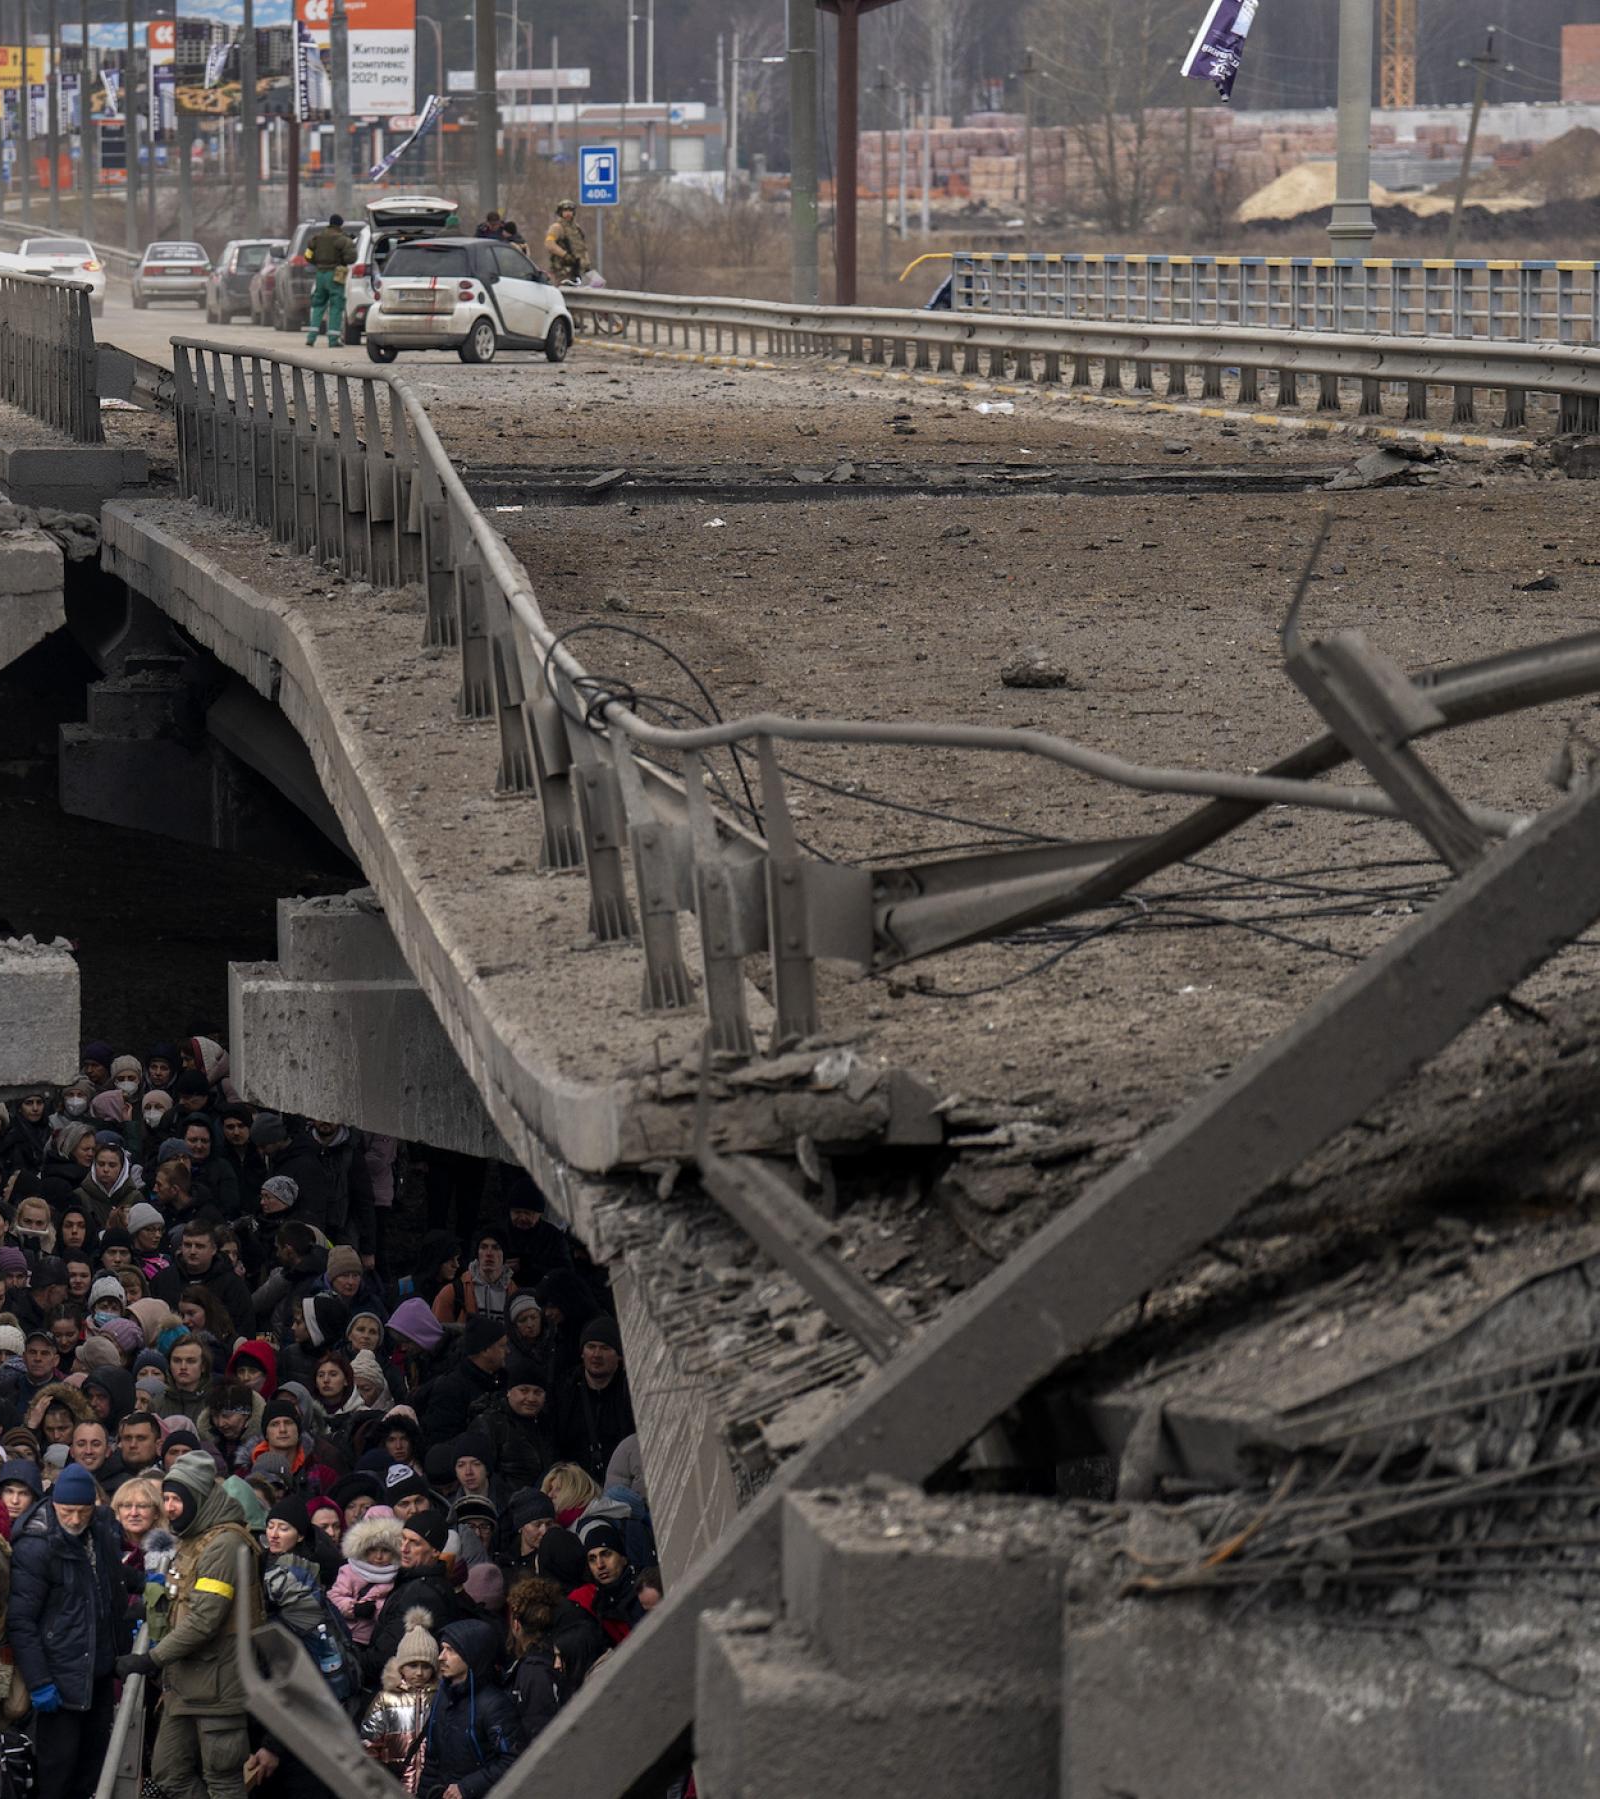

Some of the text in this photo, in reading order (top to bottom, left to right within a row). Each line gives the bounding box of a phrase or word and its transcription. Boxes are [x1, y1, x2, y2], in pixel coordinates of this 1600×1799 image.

[352, 44, 410, 54] Житловий
[352, 60, 406, 69] комплекс
[352, 73, 409, 86] 2021 року
